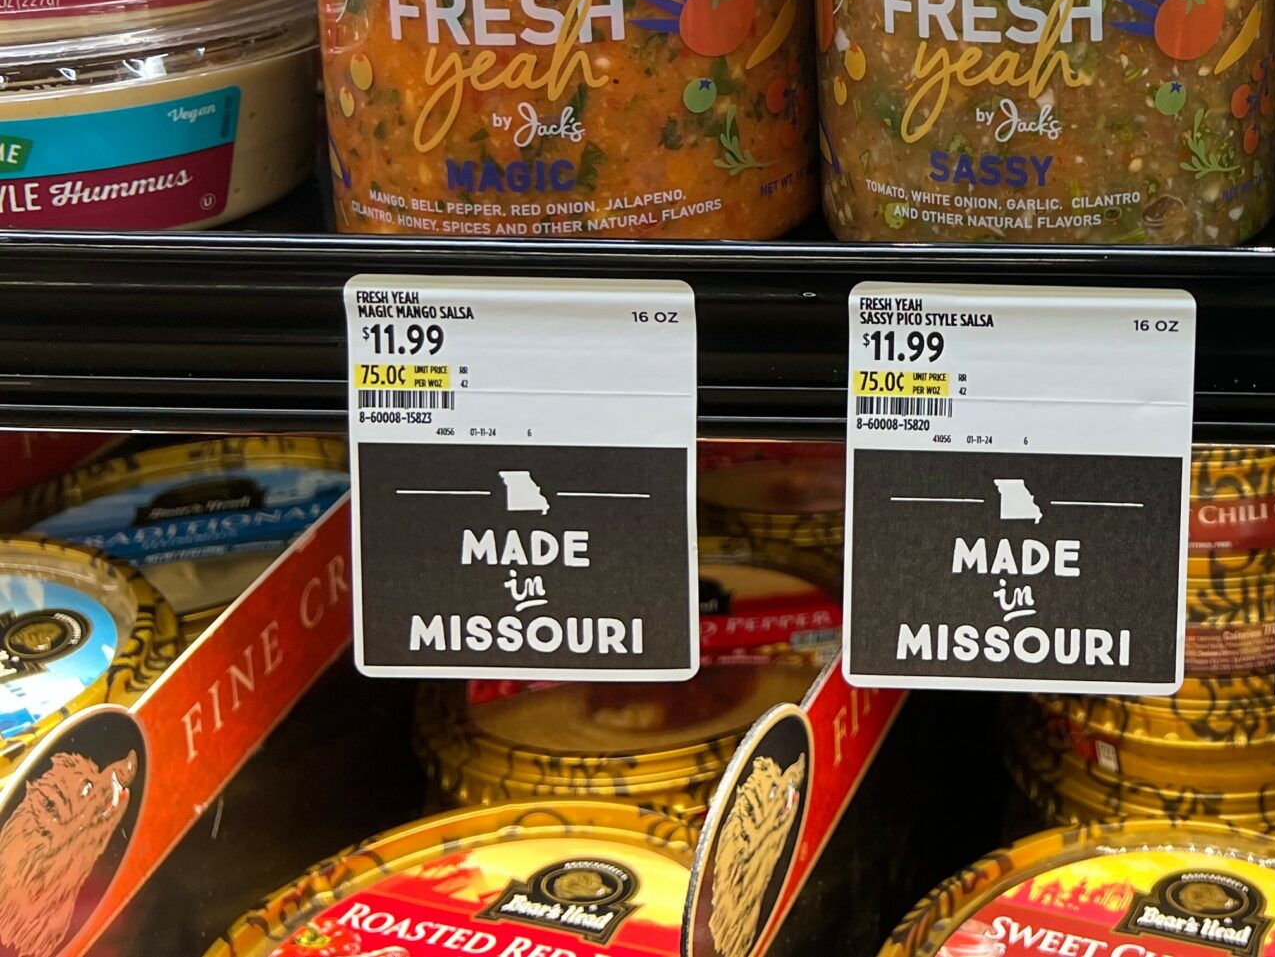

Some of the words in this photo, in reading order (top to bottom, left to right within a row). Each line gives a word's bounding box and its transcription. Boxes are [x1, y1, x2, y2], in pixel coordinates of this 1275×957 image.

[492, 114, 511, 130] by
[514, 102, 586, 147] Jack's
[976, 108, 995, 125] by
[995, 98, 1062, 142] Jack's
[446, 158, 575, 193] MAGIC
[929, 150, 1053, 187] SASSY
[49, 168, 192, 207] Hummus
[412, 199, 443, 213] BELL
[511, 203, 541, 217] RED
[357, 292, 388, 304] FRESH
[392, 292, 419, 304] YEAH
[358, 305, 394, 318] MAGIC
[396, 306, 437, 319] MANGO
[440, 306, 474, 320] SALSA
[860, 298, 892, 310] FRESH
[895, 298, 922, 311] YEAH
[632, 311, 649, 322] 16
[655, 311, 679, 323] OZ
[860, 312, 894, 325] SASSY
[897, 313, 922, 325] PICO
[925, 314, 957, 326] STYLE
[960, 314, 994, 327] SALSA
[363, 323, 444, 355] $11.99
[863, 331, 944, 362] $11.99
[430, 366, 448, 375] PRICE
[359, 411, 432, 424] 8-60008-15823
[856, 418, 930, 431] 8-60008-15820
[461, 529, 590, 567] MADE
[952, 537, 1081, 576] MADE
[504, 570, 546, 602] in
[409, 614, 644, 654] MISSOURI
[896, 623, 1130, 666] MISSOURI
[180, 620, 283, 765] FINE
[337, 902, 496, 954] ROASTED
[984, 916, 1107, 957] SWEET
